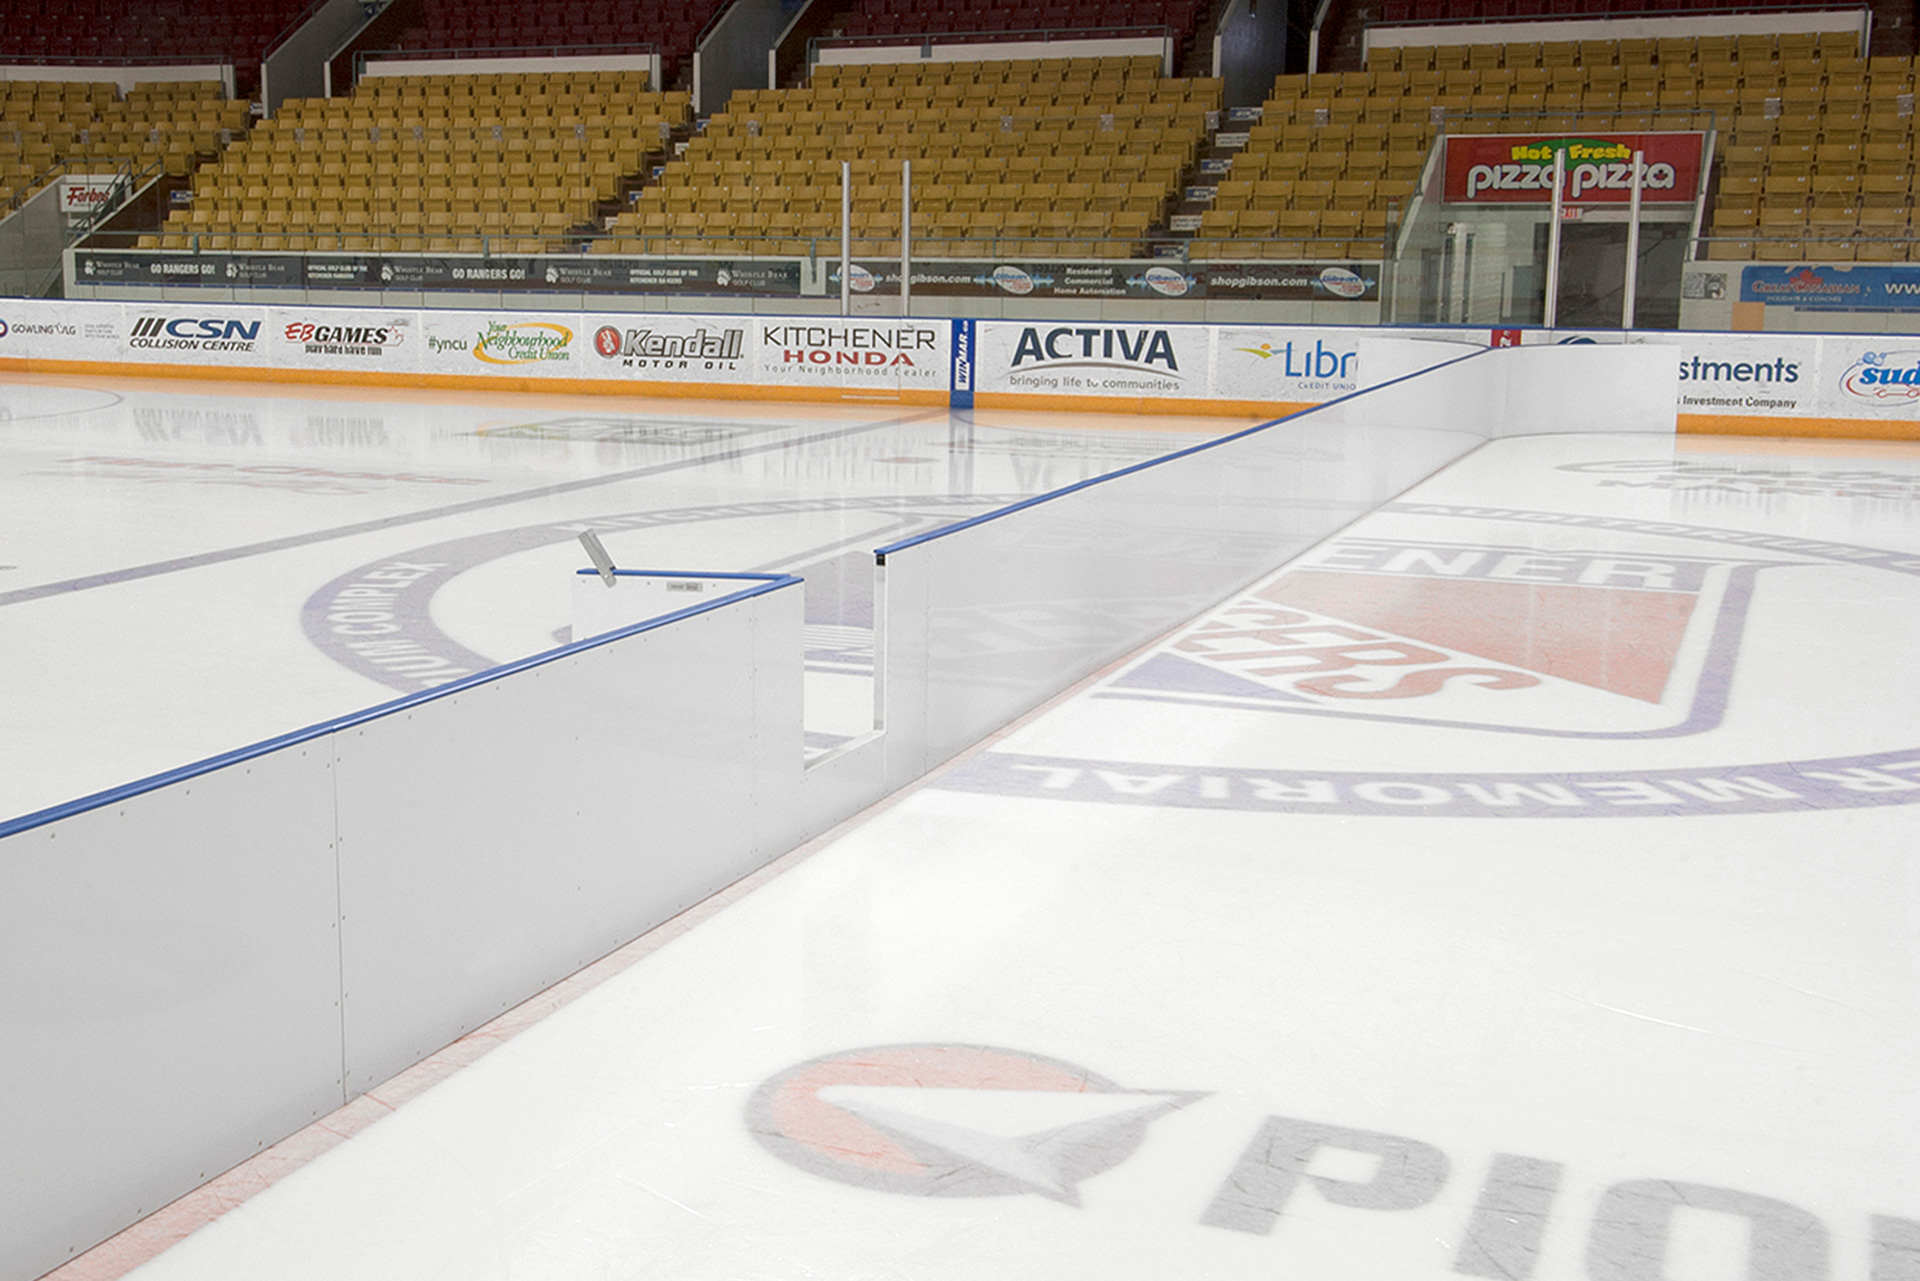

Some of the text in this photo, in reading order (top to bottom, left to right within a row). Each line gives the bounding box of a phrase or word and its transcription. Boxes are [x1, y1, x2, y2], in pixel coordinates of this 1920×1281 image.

[1511, 144, 1631, 160] Hot Fresh
[1572, 163, 1676, 199] pizza
[150, 264, 215, 275] GO RANGERS GO!
[452, 268, 525, 280] GO RANGERS GO!
[1066, 268, 1112, 276] Residential
[885, 272, 971, 286] shogibson.com
[1064, 277, 1113, 285] Commercial
[1210, 276, 1308, 288] shopgibson.com
[1054, 287, 1126, 295] Home Automation
[1752, 280, 1860, 293] GREAT CANADIAN
[11, 323, 54, 335] GOWLING
[166, 318, 261, 340] CSN
[488, 321, 507, 332] Your
[130, 338, 255, 352] COLLISION CENTRE
[428, 336, 467, 353] #yncu
[476, 331, 569, 350] Neighbourhood
[623, 328, 743, 359] Kendall
[764, 326, 936, 350] KITCHENER
[508, 348, 569, 361] Credit Union
[1011, 327, 1179, 371] ACTIVA
[622, 359, 736, 370] MOTOR OIL
[784, 350, 914, 367] HONDA
[1285, 339, 1358, 378] Libr
[764, 364, 792, 373] Your
[800, 365, 888, 377] Neighborhood
[1010, 376, 1058, 389] bringing
[1063, 376, 1082, 388] life
[1102, 378, 1180, 391] communities
[1297, 382, 1329, 390] CREDIT
[1683, 395, 1743, 406] Investment
[1745, 397, 1797, 409] Company
[553, 498, 907, 532] KITCHENER
[1409, 506, 1891, 559] AUDITORIUM
[326, 562, 450, 635] COMPLEX
[1010, 764, 1803, 807] MEMORIAL
